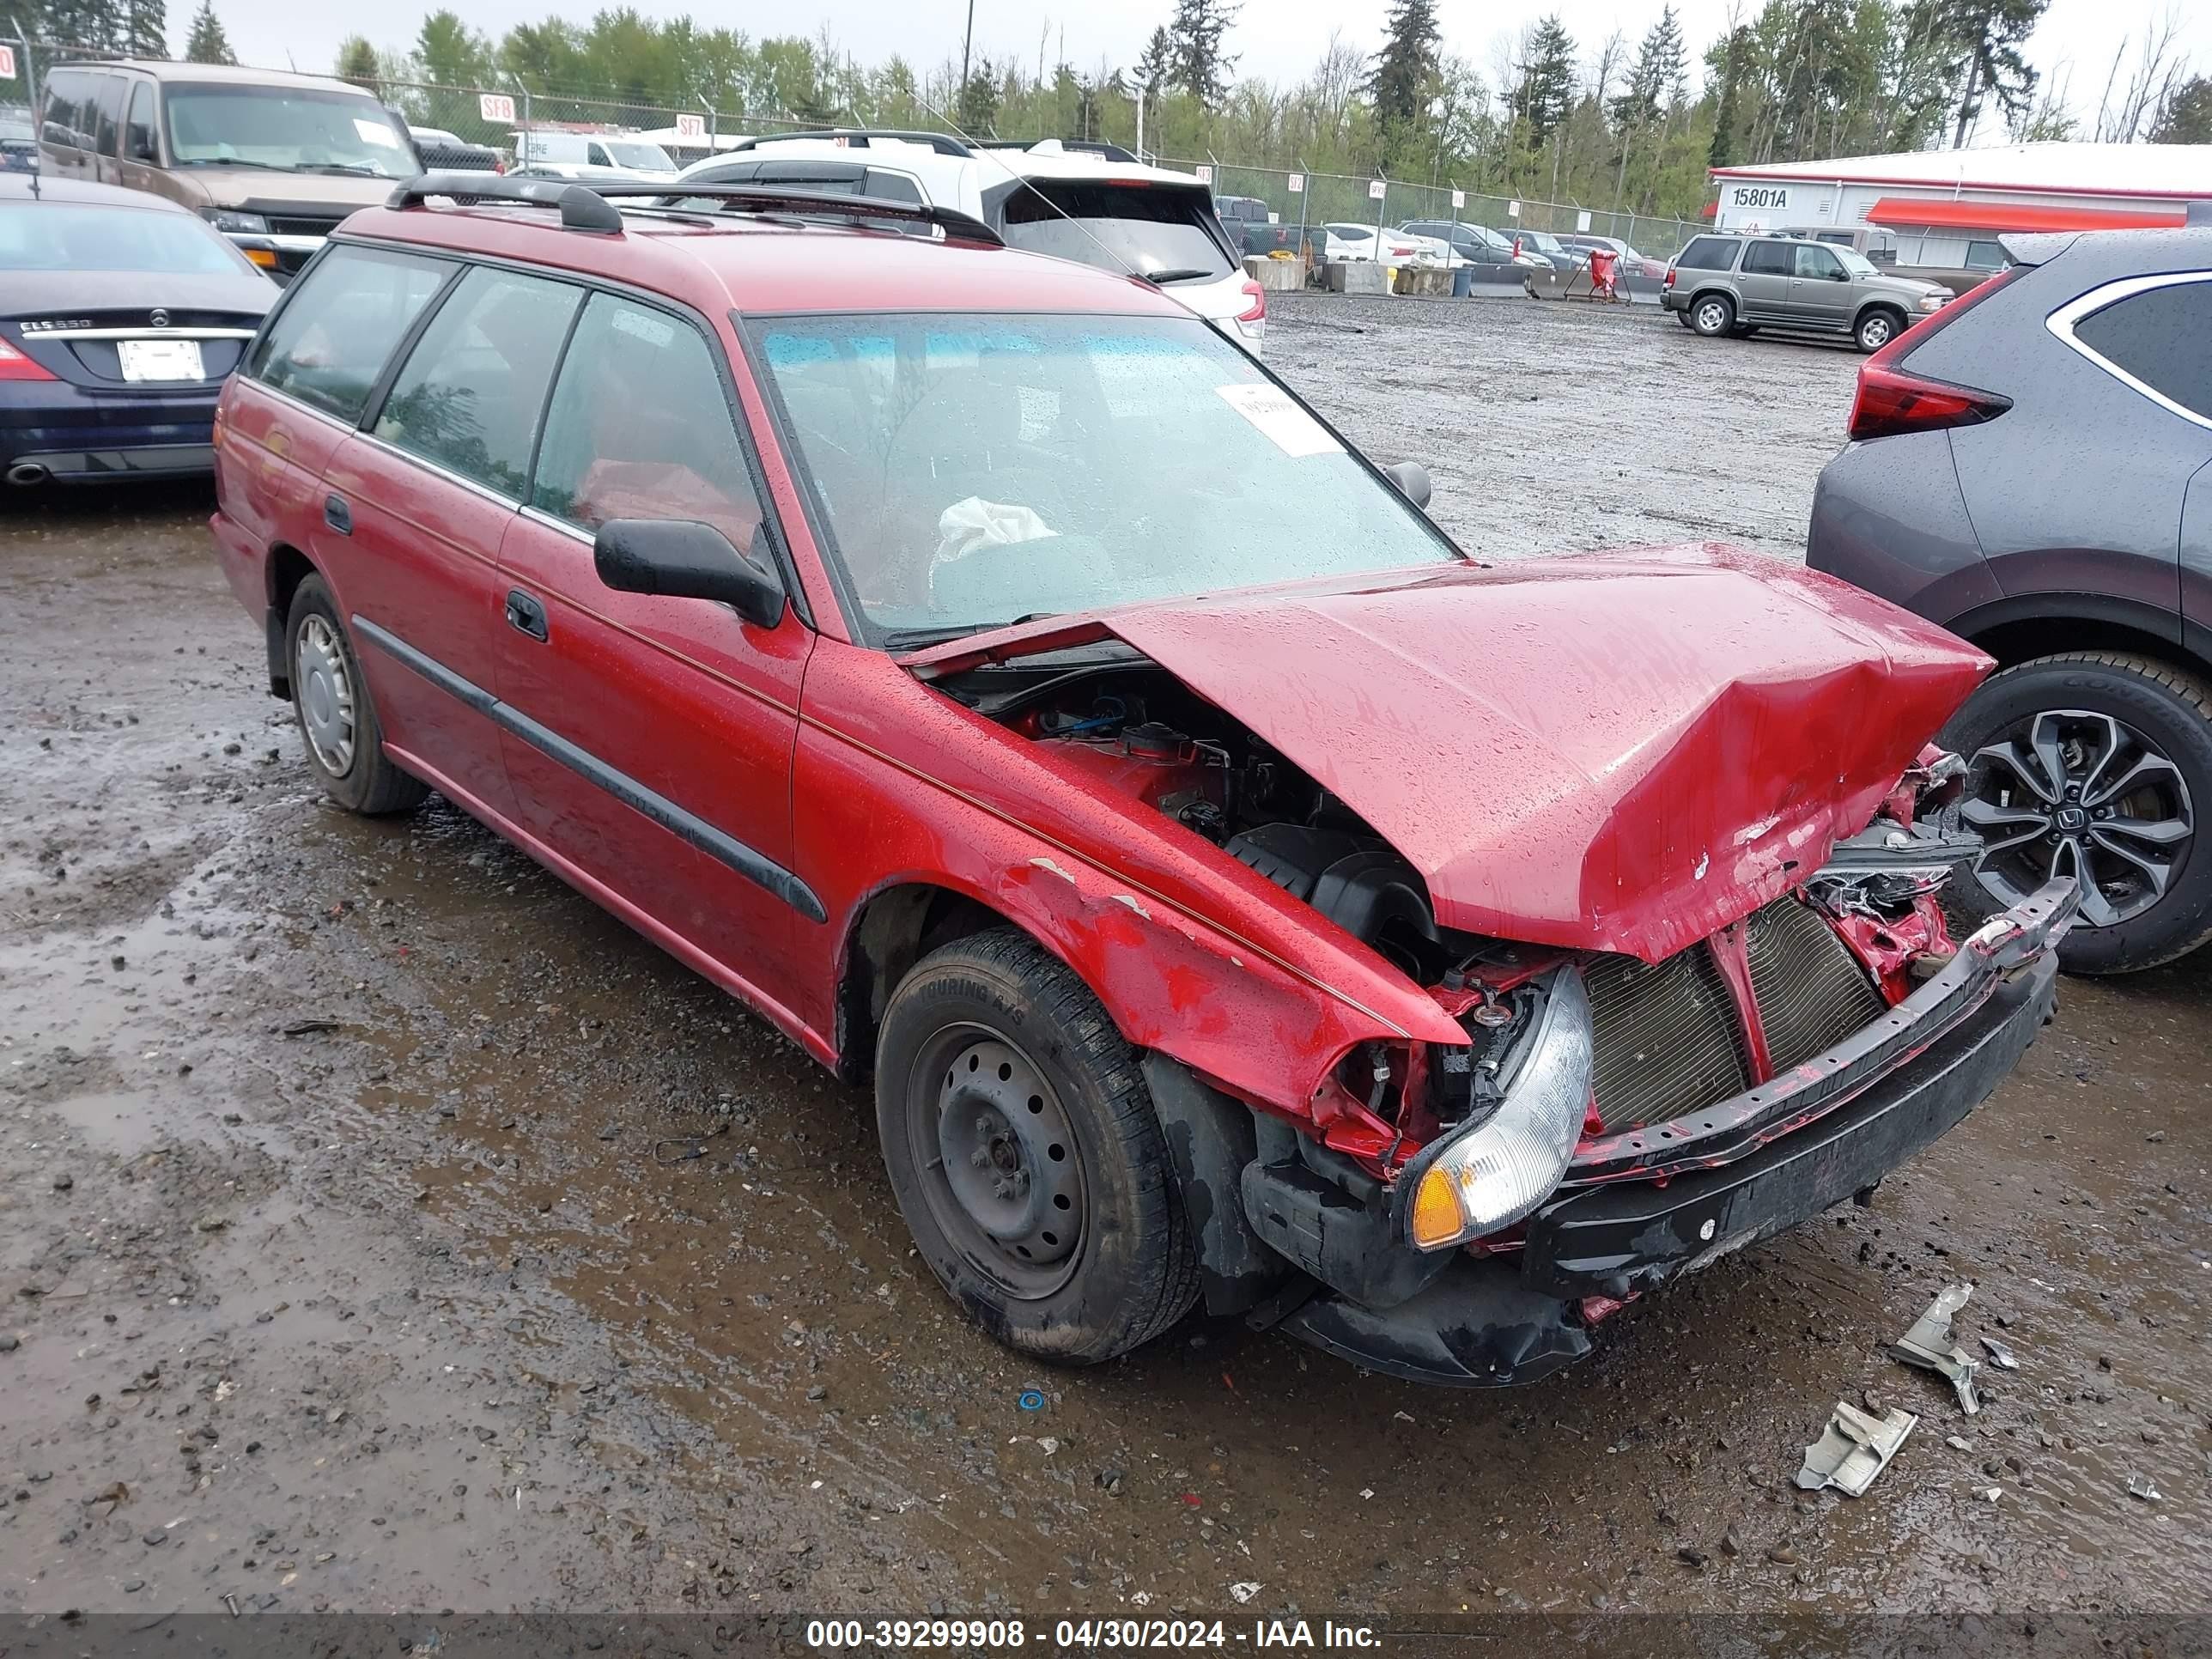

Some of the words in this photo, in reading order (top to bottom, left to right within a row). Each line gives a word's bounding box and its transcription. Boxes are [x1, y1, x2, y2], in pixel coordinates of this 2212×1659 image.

[483, 96, 512, 118] SF8
[680, 117, 701, 136] SF7
[1197, 167, 1211, 182] SF3
[1290, 175, 1302, 190] SF2
[1733, 187, 1787, 208] 15801A
[919, 978, 988, 1004] TOURING
